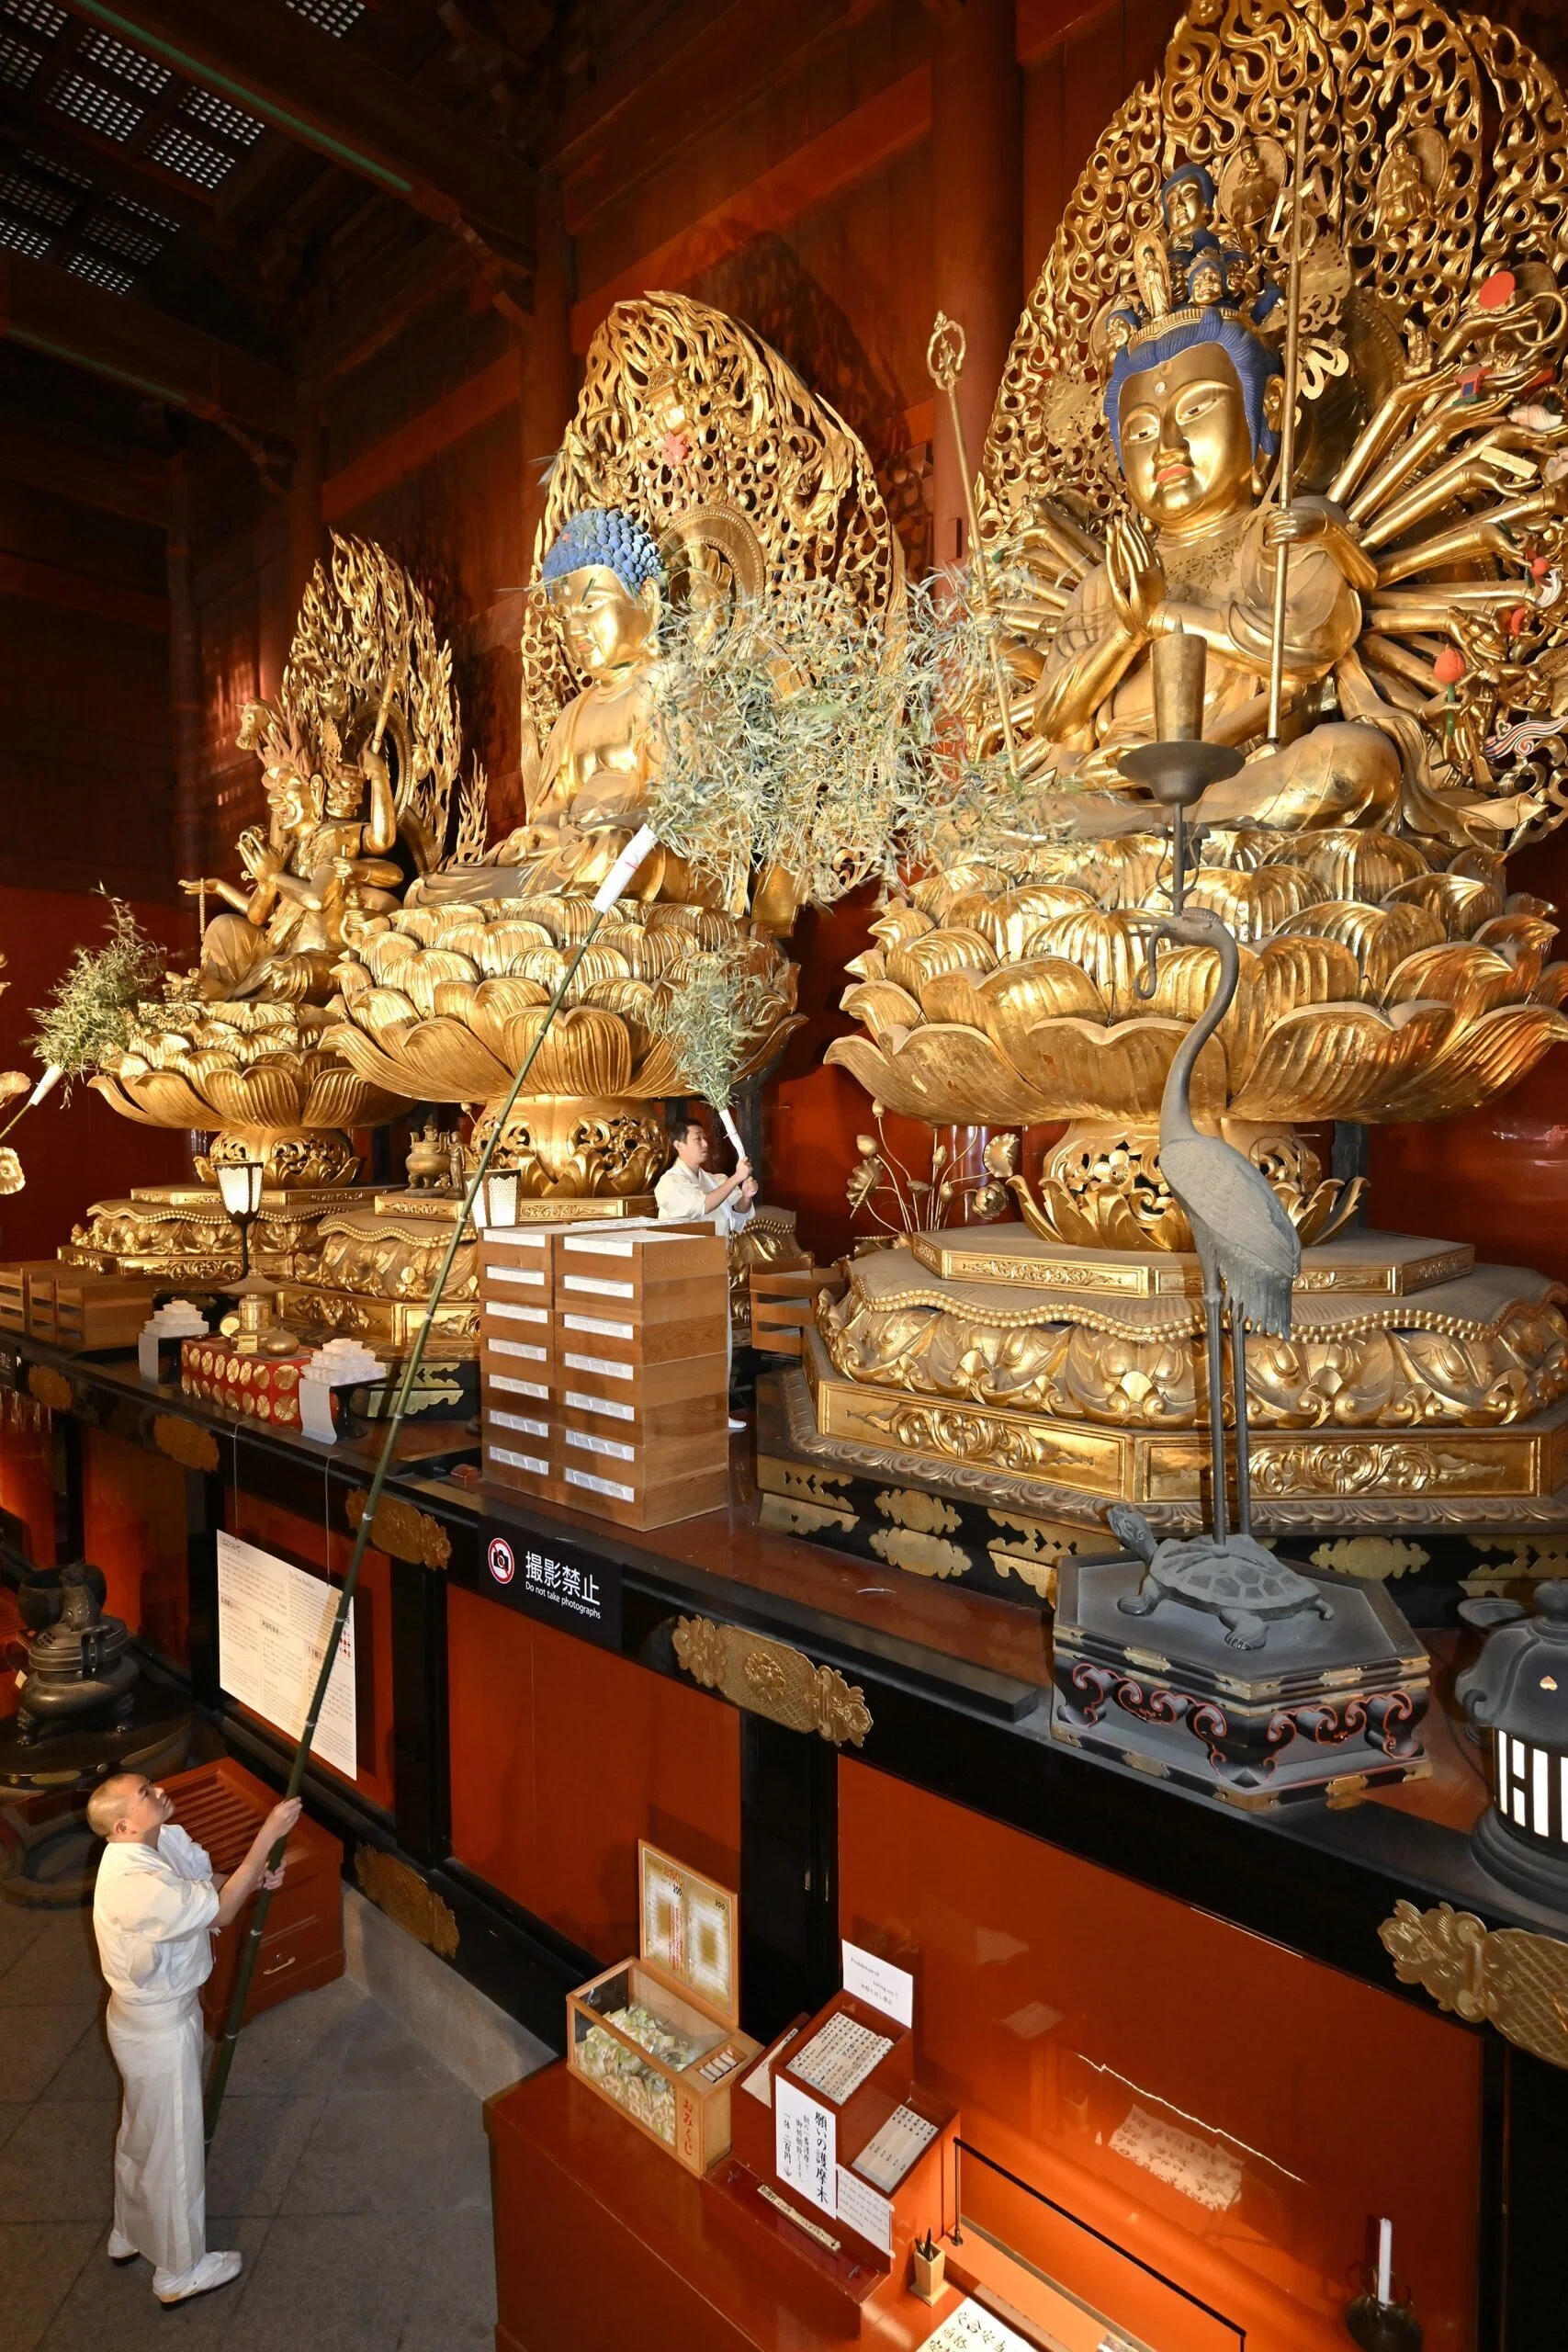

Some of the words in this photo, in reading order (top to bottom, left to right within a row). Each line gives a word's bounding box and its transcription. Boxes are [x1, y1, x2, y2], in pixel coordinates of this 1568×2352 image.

[525, 1551, 600, 1605] 撮影禁止
[525, 1581, 535, 1592] Do
[536, 1587, 546, 1597] not
[547, 1590, 560, 1602] take
[561, 1597, 601, 1619] photographs
[683, 2098, 693, 2155] おみくじ
[815, 2111, 829, 2204] 願いの護摩木
